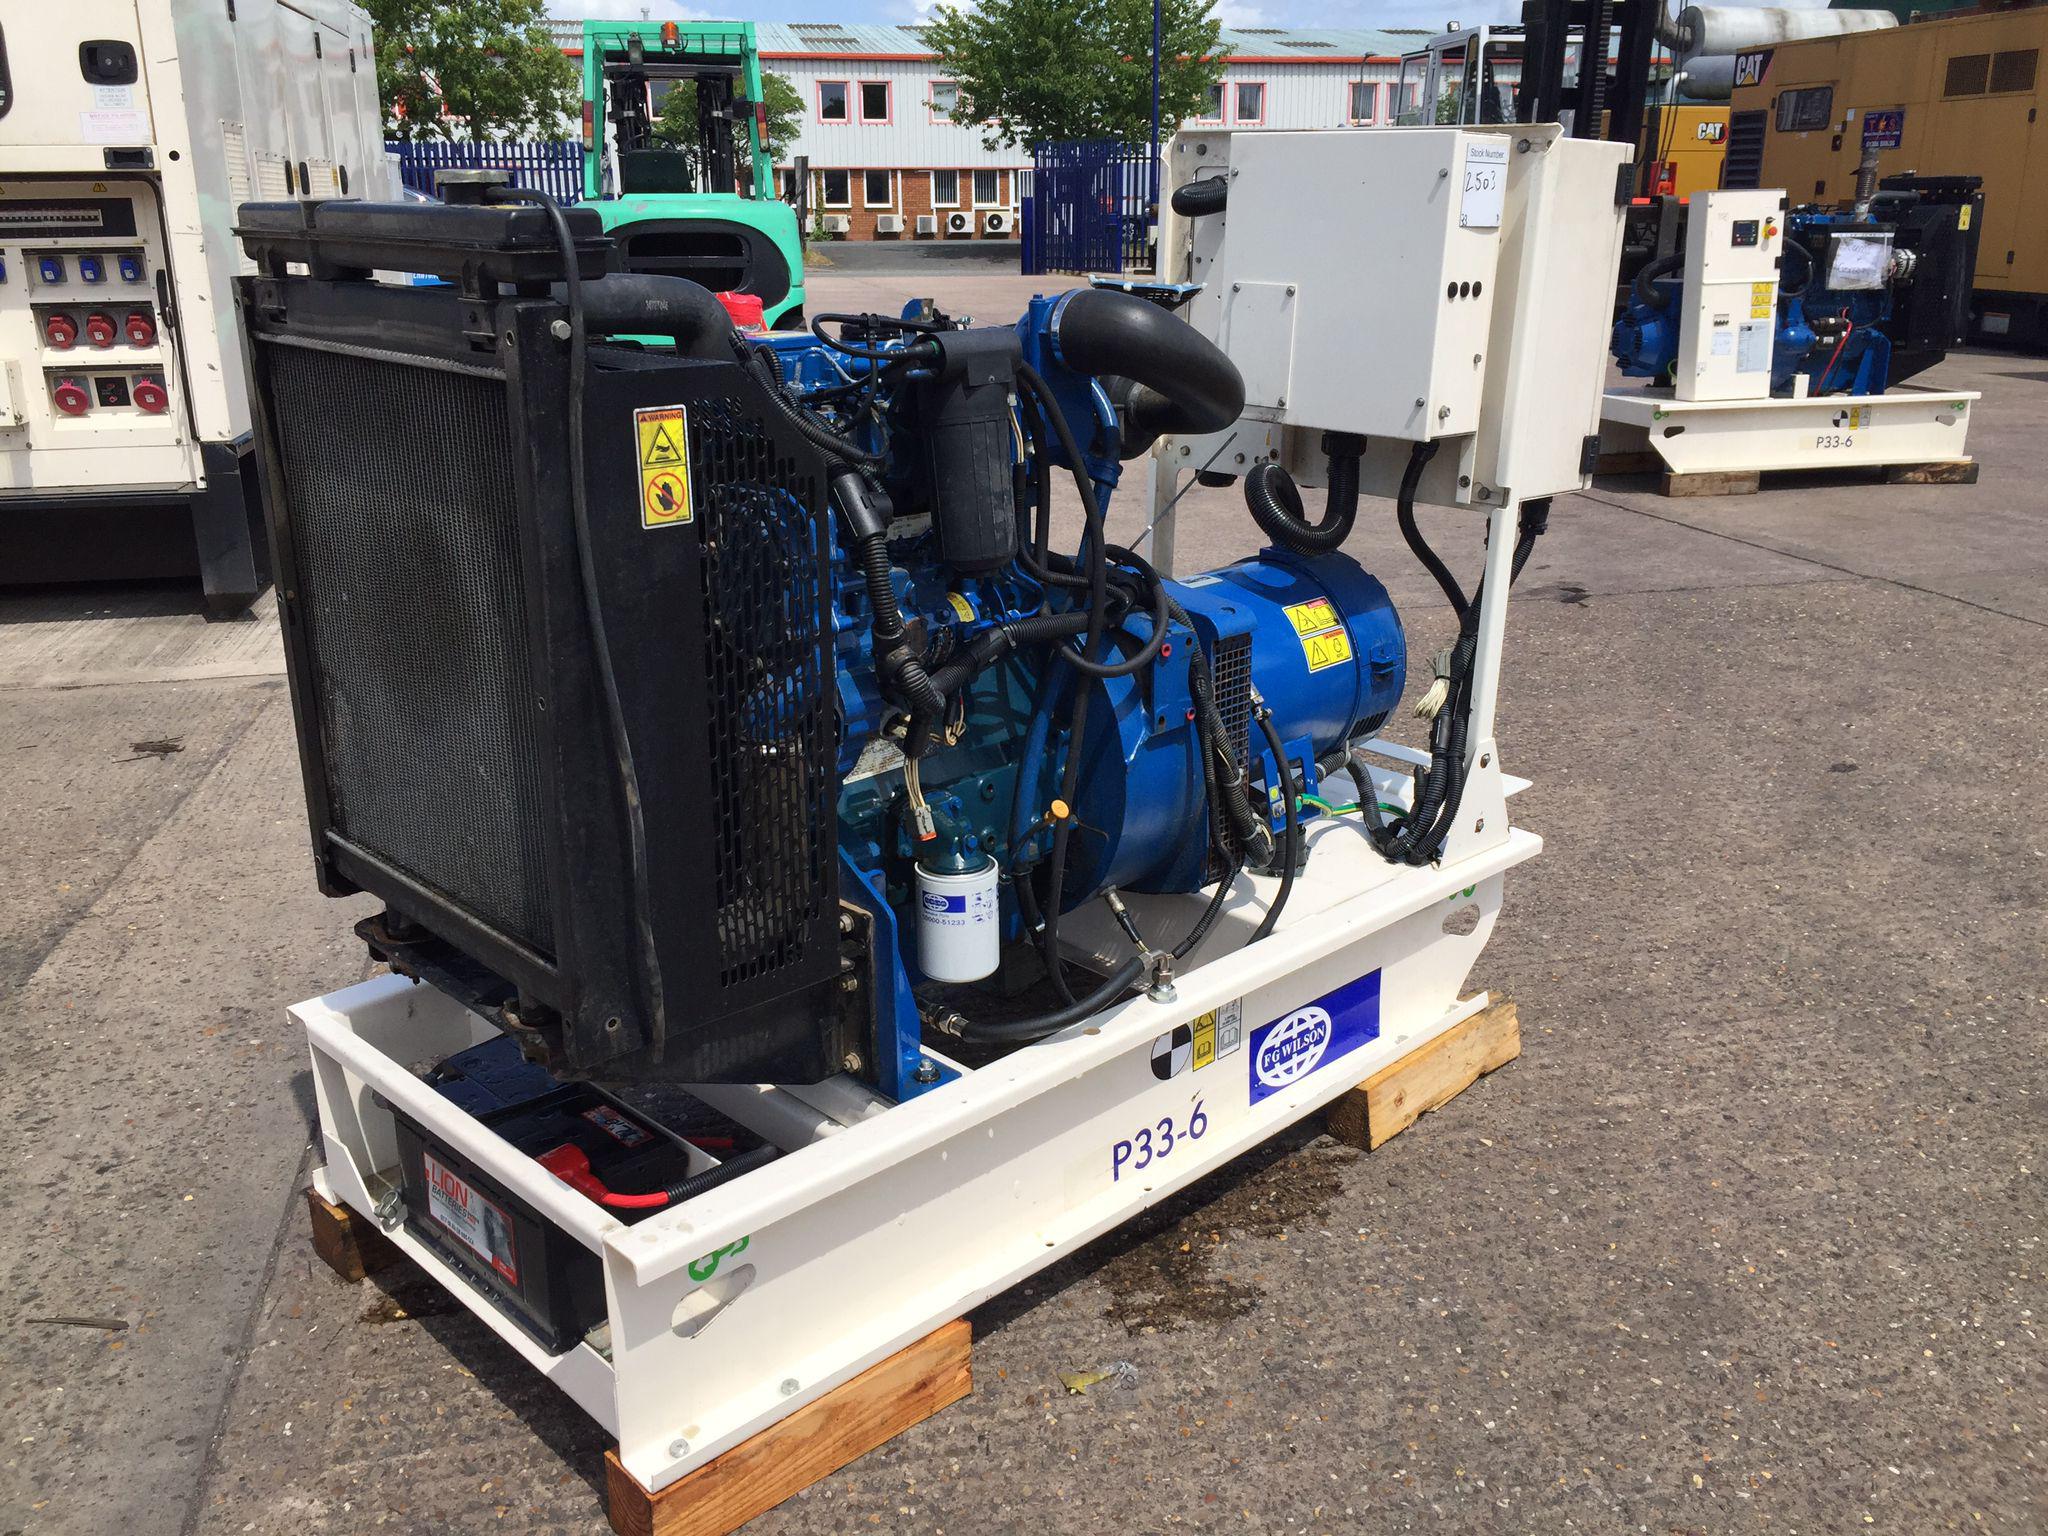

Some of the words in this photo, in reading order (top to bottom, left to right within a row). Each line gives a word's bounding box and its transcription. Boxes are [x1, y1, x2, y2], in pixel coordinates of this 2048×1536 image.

[1736, 54, 1764, 86] CAT
[1697, 122, 1723, 140] CAT
[1470, 147, 1485, 157] Stock
[1485, 149, 1505, 159] Number
[1465, 170, 1496, 192] 2503
[648, 411, 682, 421] WARNING
[1816, 435, 1853, 448] P33-6
[1263, 1048, 1281, 1069] FG
[1281, 1024, 1326, 1058] WILSON
[1113, 1098, 1208, 1182] P33-6
[431, 1160, 468, 1208] LION
[431, 1184, 468, 1218] BATTERIES
